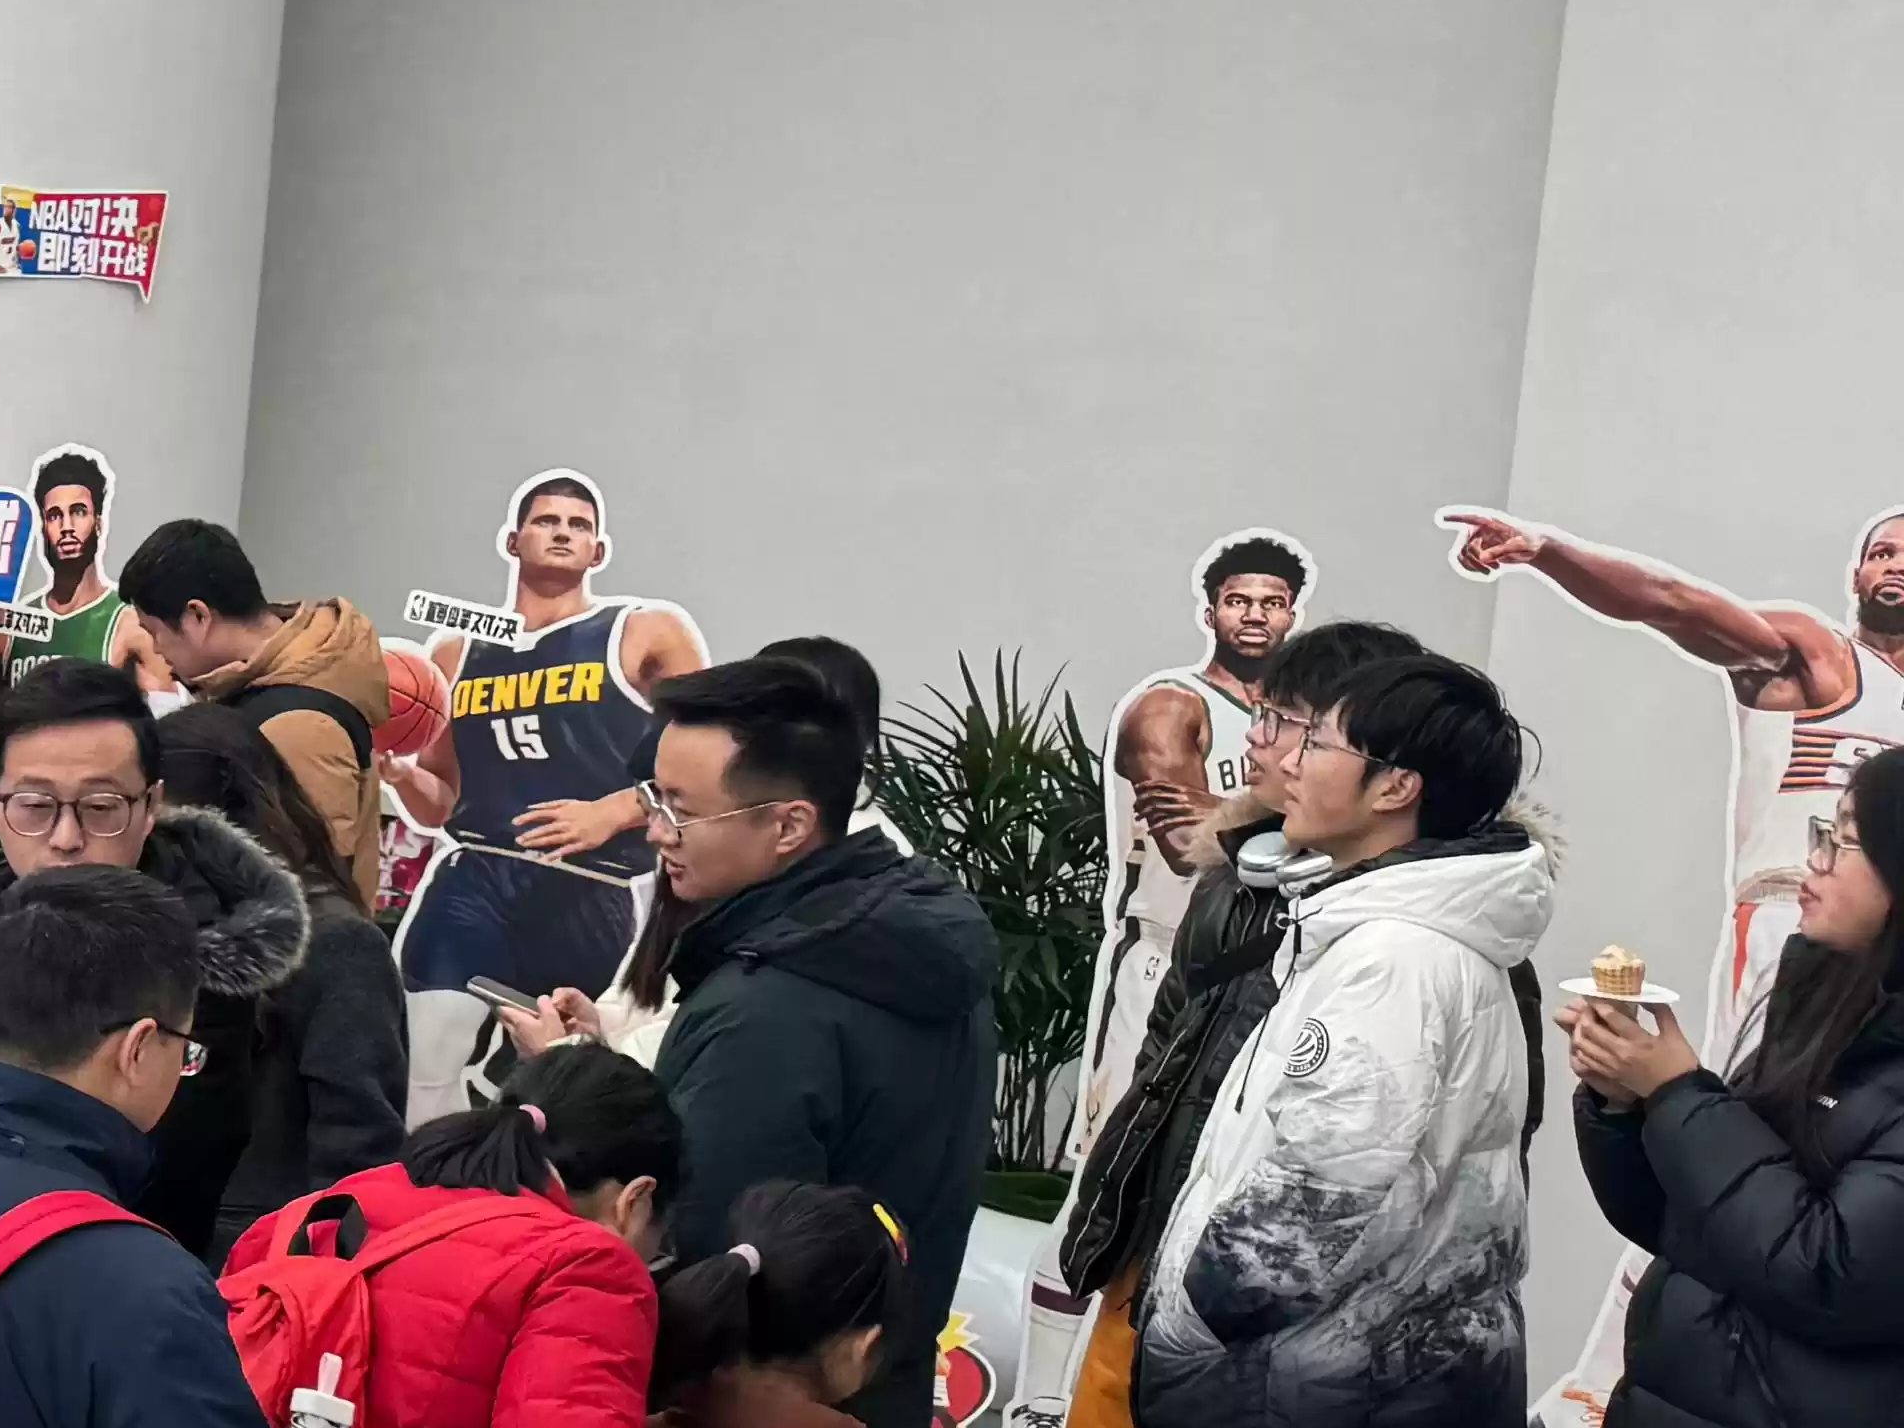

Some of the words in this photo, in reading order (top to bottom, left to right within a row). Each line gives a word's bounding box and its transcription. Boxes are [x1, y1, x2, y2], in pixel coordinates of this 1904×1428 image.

[29, 196, 139, 238] NBA对决
[37, 231, 149, 277] 即刻开战
[452, 662, 604, 719] DENVER
[491, 714, 550, 761] 15
